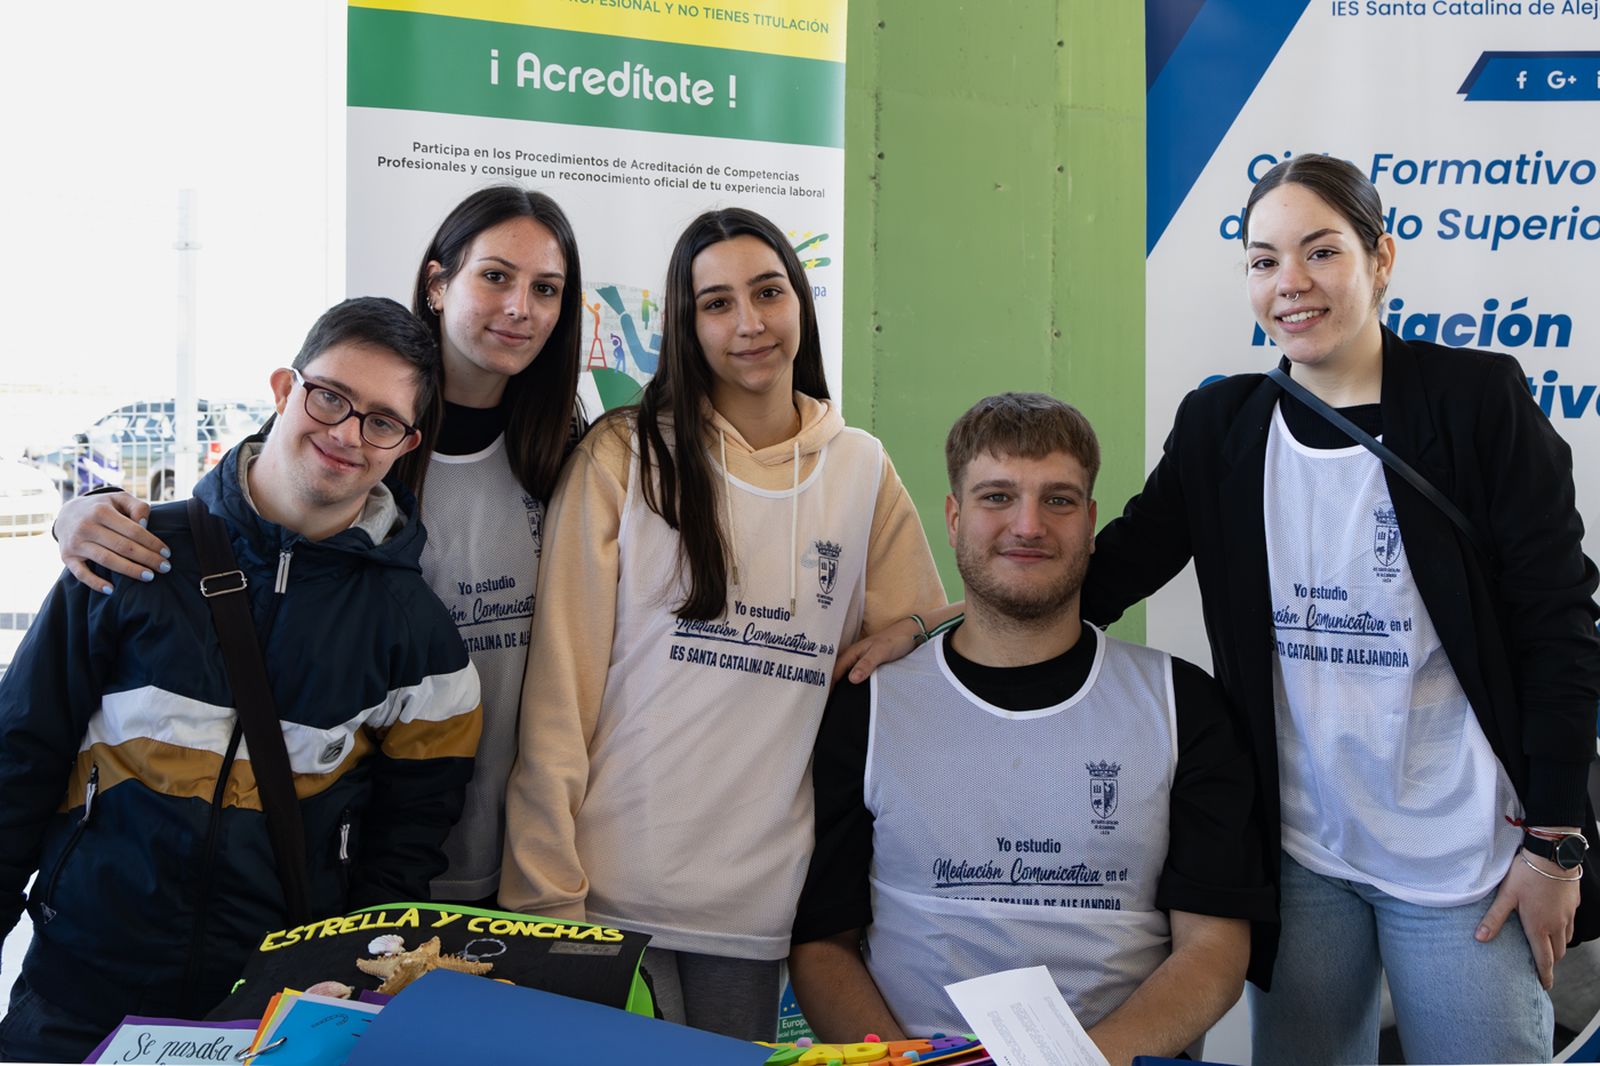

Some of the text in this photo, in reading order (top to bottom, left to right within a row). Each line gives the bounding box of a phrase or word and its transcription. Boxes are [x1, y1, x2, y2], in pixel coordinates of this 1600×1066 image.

[569, 0, 830, 34] ESIONAL Y NO TIENES TITULACIÓN
[1331, 1, 1359, 17] IES
[1366, 0, 1427, 17] Santa
[1432, 0, 1522, 16] Catalina
[1528, 0, 1555, 15] de
[516, 51, 714, 107] Acredítate
[413, 141, 800, 182] Participa en los Procedimientos de Acreditación de Competencias
[1370, 151, 1597, 185] Formativo
[377, 156, 825, 199] Profesionales y consigue un reconocimiento oficial de tu experiencia laboral
[458, 575, 516, 595] Yo estudio
[1293, 583, 1348, 601] Yo estudio
[473, 593, 536, 622] Comunicat
[735, 600, 791, 622] Yo estudio
[1306, 604, 1387, 634] Comunicativa
[1390, 621, 1401, 631] en
[1403, 618, 1412, 632] el
[464, 634, 501, 653] ATALINA
[505, 632, 517, 648] DE
[743, 622, 818, 653] Comunicativa
[670, 645, 685, 661] IES
[687, 647, 717, 668] SANTA
[720, 653, 763, 674] CATALINA
[763, 661, 775, 677] DE
[1287, 642, 1328, 661] CATALINA
[1331, 648, 1344, 664] DE
[1346, 647, 1410, 668] ALEJANDRÍA
[997, 837, 1062, 854] Yo estudio
[933, 857, 1128, 884] Mediación Comunicativa en el
[259, 907, 625, 952] ESTRELLA Y CONCHAS
[782, 1018, 808, 1029] Europ
[123, 1032, 157, 1063] Se
